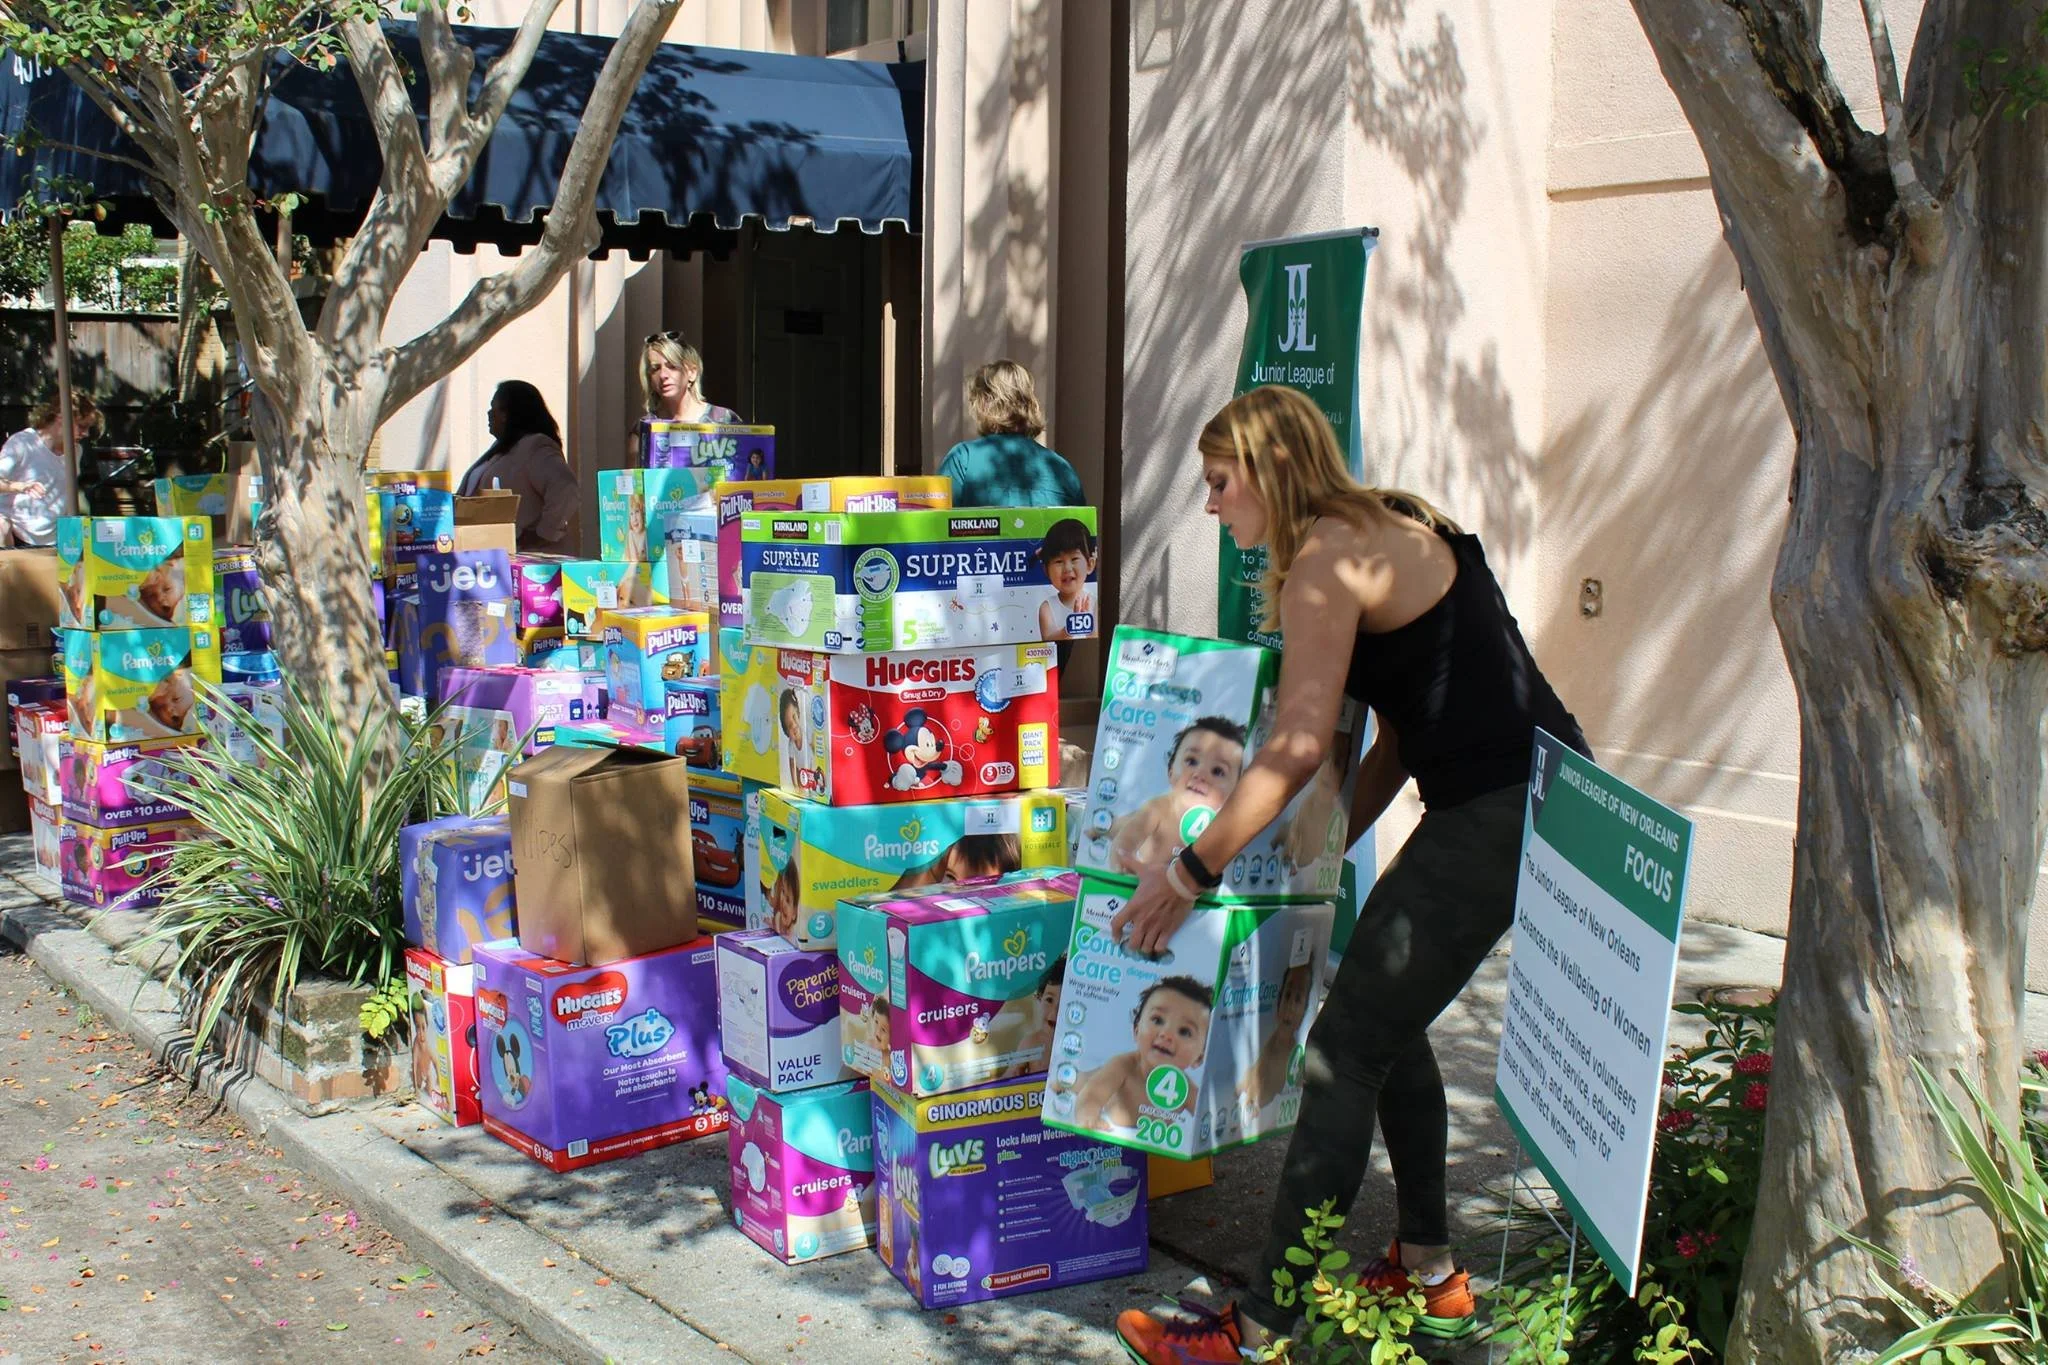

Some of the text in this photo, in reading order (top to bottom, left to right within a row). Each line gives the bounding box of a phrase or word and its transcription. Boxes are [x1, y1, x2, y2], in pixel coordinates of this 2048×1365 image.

[1251, 361, 1334, 389] Junior League of
[691, 437, 737, 465] Luvs
[652, 496, 683, 511] Pampe
[774, 521, 808, 532] KIRKLAND
[951, 519, 999, 529] KIRKLAND
[114, 542, 167, 557] Pampers
[763, 548, 819, 568] SUPRÊME
[906, 547, 1027, 578] SUPRÊME
[428, 560, 497, 592] jet
[903, 620, 918, 645] 5
[1069, 615, 1091, 630] 150
[648, 628, 696, 656] Pull-Ups
[826, 632, 840, 645] 150
[122, 652, 175, 671] Pampers
[781, 651, 811, 674] HUGGIES
[866, 656, 976, 688] HUGGIES
[667, 694, 707, 716] Pull-Ups
[903, 692, 921, 701] Snug
[929, 690, 941, 698] Dry
[1108, 700, 1157, 728] Care
[986, 766, 1011, 777] 5 136
[105, 804, 186, 820] OVER $10 SAVI
[1034, 808, 1052, 828] #1
[1559, 762, 1679, 853] JUNIOR LEAGUE OF NEW ORLEANS
[1188, 810, 1211, 838] 4
[112, 830, 147, 850] Pull-Ups
[864, 834, 939, 859] Pampers
[463, 850, 515, 881] jet
[1624, 845, 1673, 902] FOCUS
[812, 875, 880, 891] swaddlers
[698, 893, 745, 917] $10 SAVIN
[1525, 852, 1641, 972] The Junior League of New Orleans
[815, 919, 825, 931] 5
[848, 950, 883, 983] Pampers
[964, 950, 1047, 984] Pampers
[1072, 954, 1121, 984] Care
[785, 963, 839, 995] Parent's
[1518, 909, 1650, 1057] Advances the Wellbeing of Women
[557, 989, 622, 1016] HUGGIES
[794, 986, 839, 1008] Choice
[841, 983, 867, 1002] cruisers
[567, 1013, 614, 1031] movers
[917, 1002, 979, 1024] cruisers
[1071, 1009, 1081, 1019] 12
[608, 1022, 665, 1053] Plus
[1513, 961, 1637, 1115] through the use of trained volunteers
[603, 1051, 687, 1076] Our Most Absorbent
[778, 1055, 821, 1071] VALUE
[1509, 989, 1625, 1141] that provide direct service, educate
[618, 1076, 640, 1087] Notre
[778, 1070, 814, 1086] PACK
[926, 1068, 936, 1082] 4
[616, 1087, 632, 1098] plus
[1153, 1070, 1179, 1106] 4
[1503, 1042, 1577, 1157] issues that affect women.
[1507, 1016, 1611, 1161] the community, and advocate for
[927, 1093, 1024, 1123] GINORMOUS
[698, 1111, 729, 1130] 3 198
[997, 1132, 1041, 1148] Locks Away
[1136, 1116, 1183, 1149] 200
[541, 1147, 553, 1163] 198
[929, 1138, 985, 1180] Luvs
[1098, 1146, 1122, 1160] Lock
[792, 1174, 852, 1197] cruisers
[801, 1236, 812, 1250] 4
